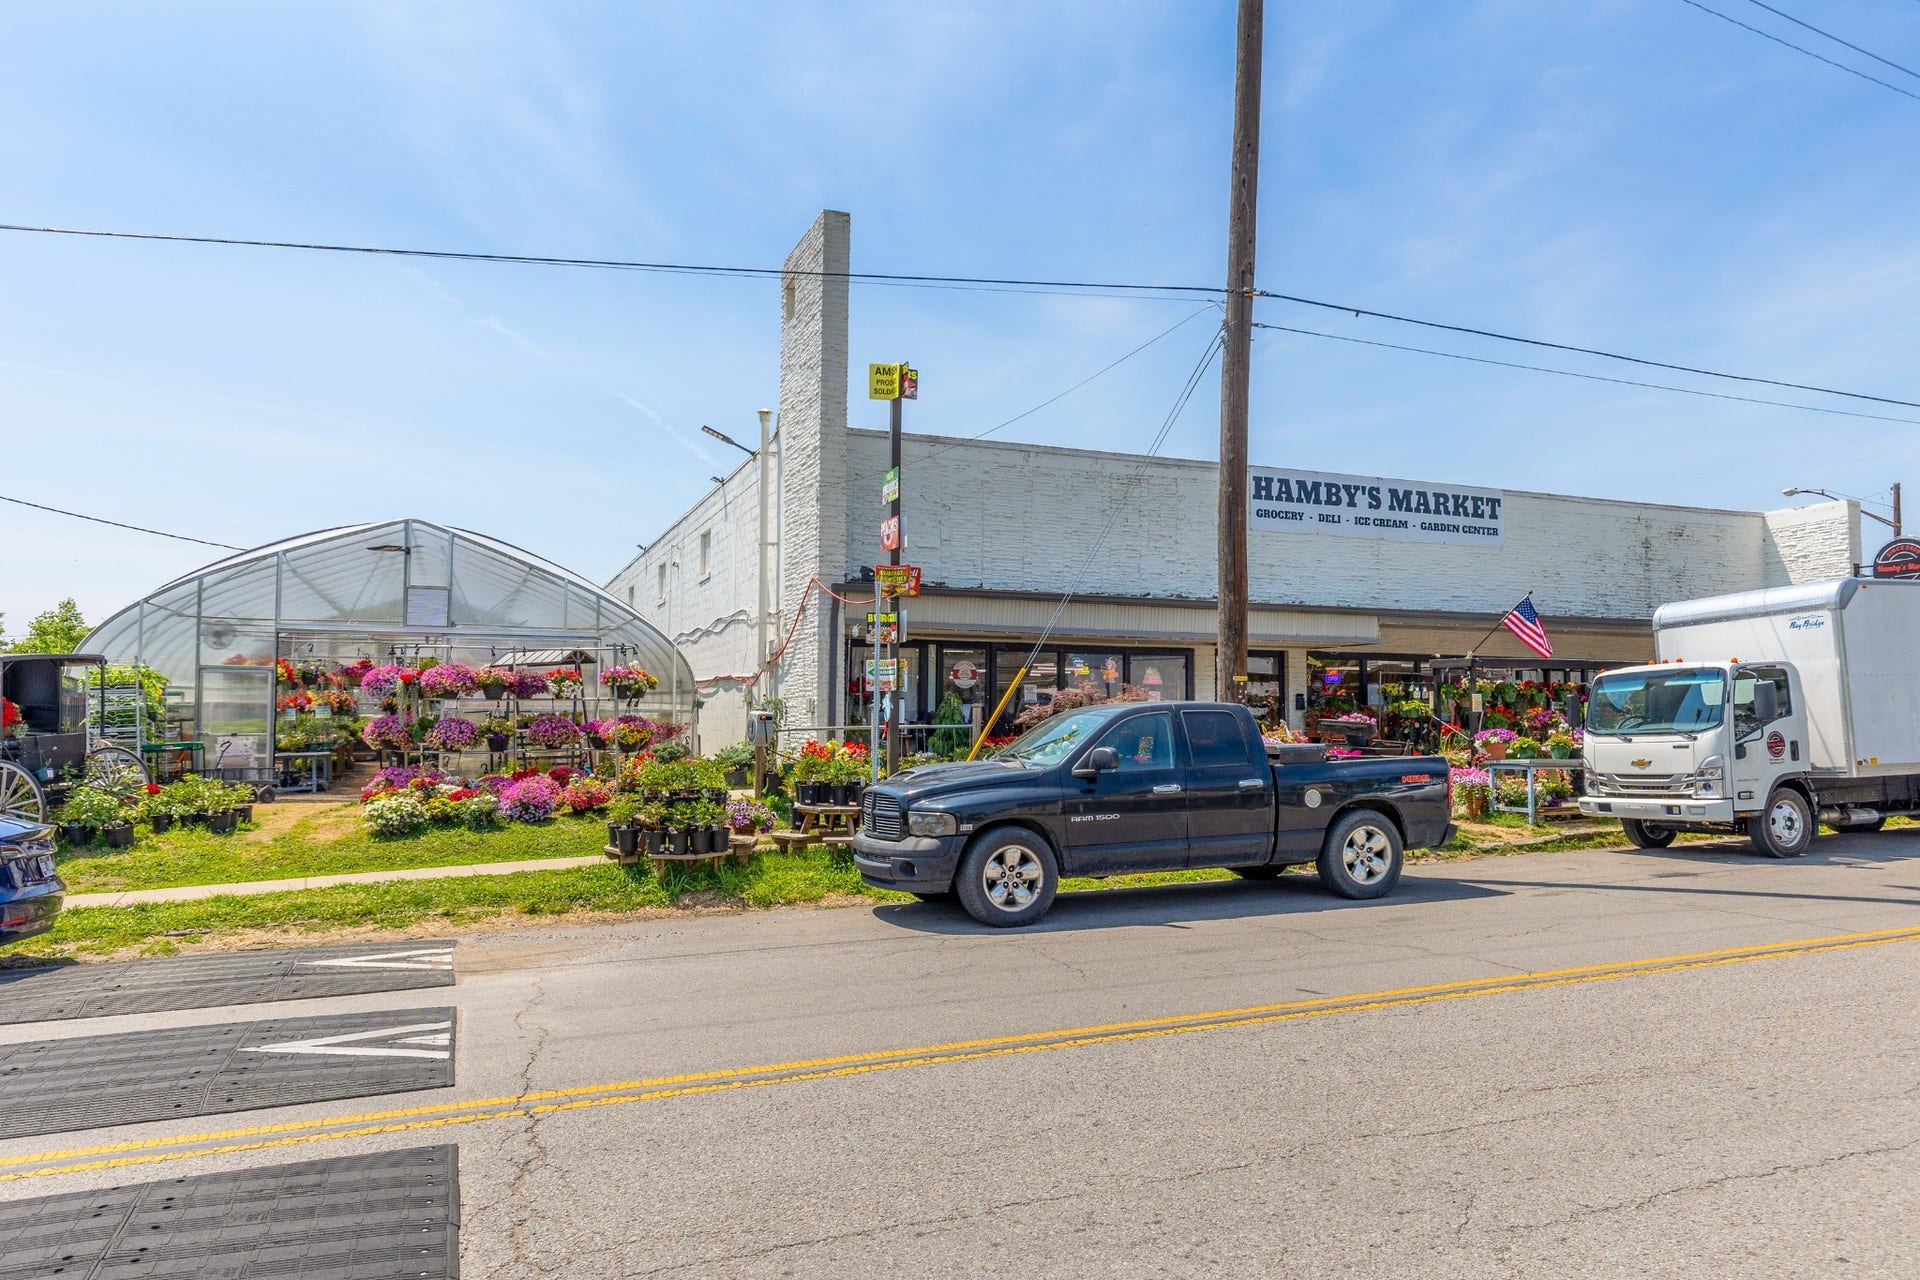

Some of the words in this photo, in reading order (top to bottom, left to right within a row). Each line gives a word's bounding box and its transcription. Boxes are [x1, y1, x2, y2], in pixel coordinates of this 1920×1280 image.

[1252, 475, 1382, 511] HAMBY'S
[1388, 487, 1502, 521] MARKET
[1256, 508, 1305, 522] GROCERY
[1318, 513, 1342, 524] DELI
[1354, 516, 1372, 527] ICE
[1373, 517, 1409, 530] CREAM
[1420, 521, 1461, 534] GARDEN
[1462, 524, 1500, 537] CENTER
[1095, 813, 1121, 821] 1500
